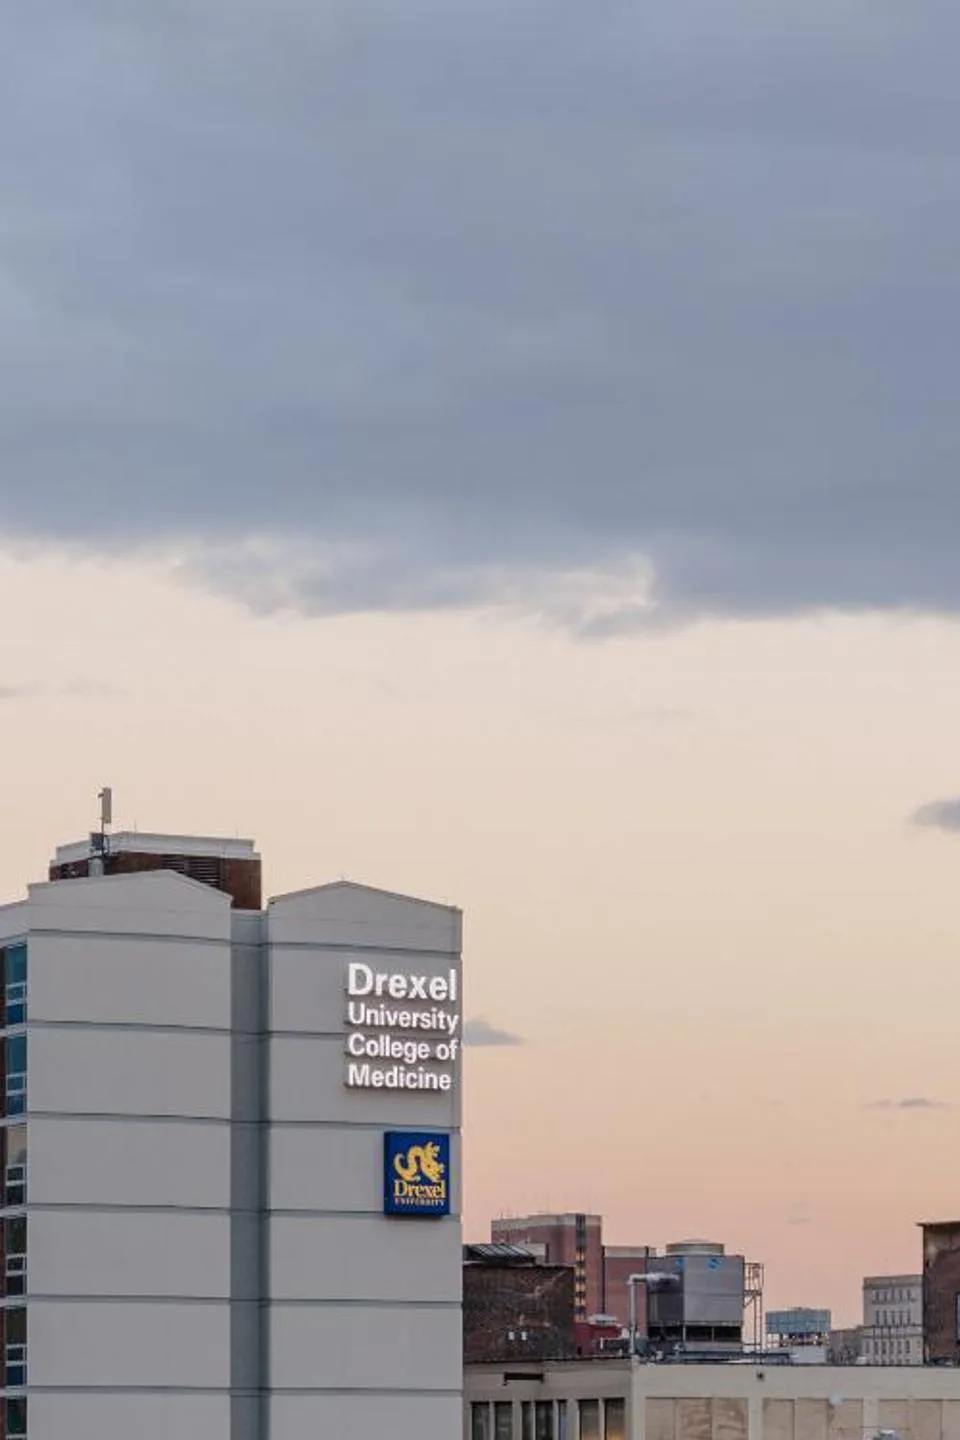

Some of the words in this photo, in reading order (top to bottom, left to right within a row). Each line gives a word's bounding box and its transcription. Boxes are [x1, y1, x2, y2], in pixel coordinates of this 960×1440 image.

[348, 962, 457, 1001] Drexel
[348, 1001, 459, 1035] University
[348, 1032, 430, 1064] College
[436, 1038, 458, 1060] of
[348, 1063, 452, 1090] Medicine
[394, 1179, 446, 1198] Drexel
